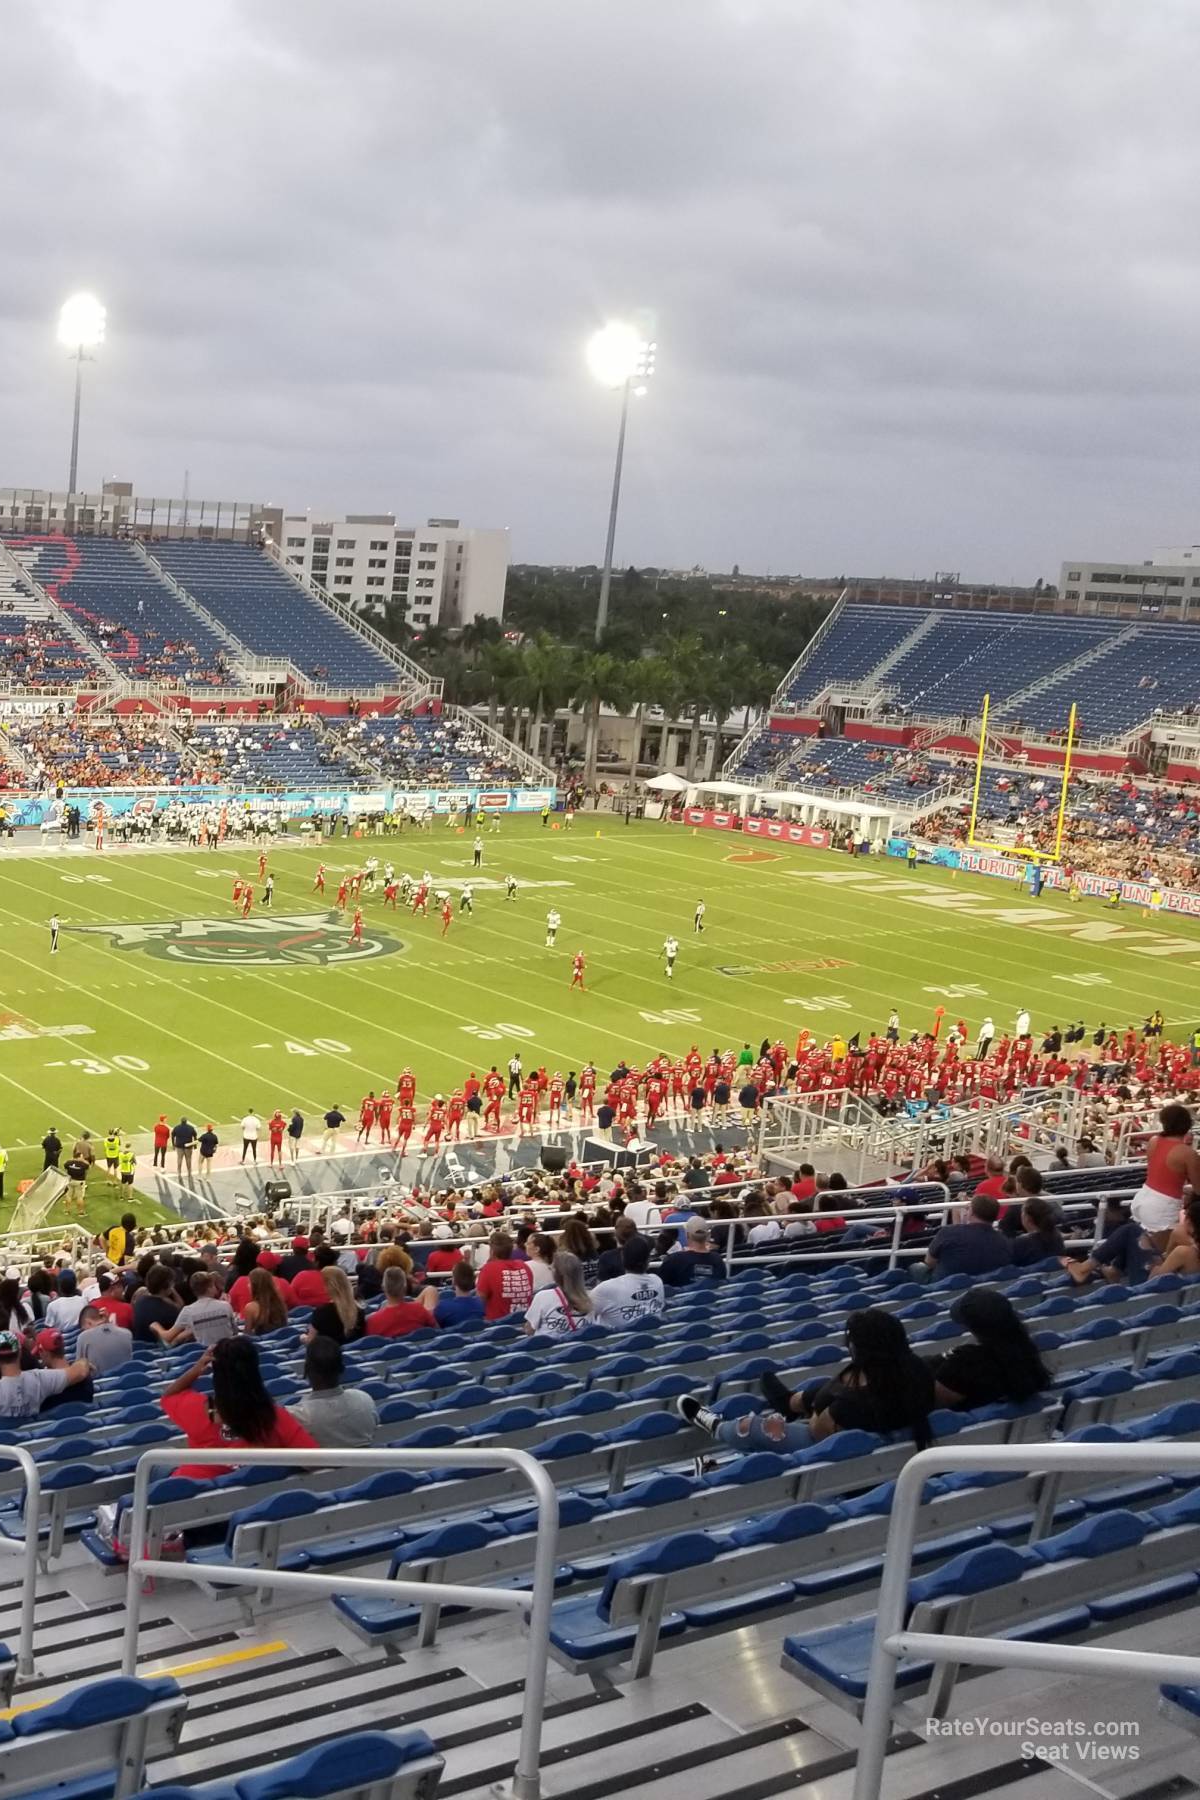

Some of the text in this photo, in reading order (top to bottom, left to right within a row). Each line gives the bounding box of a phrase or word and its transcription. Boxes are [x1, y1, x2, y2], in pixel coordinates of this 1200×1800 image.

[459, 1023, 536, 1041] 50
[282, 1038, 352, 1056] 40
[67, 1055, 151, 1075] 30
